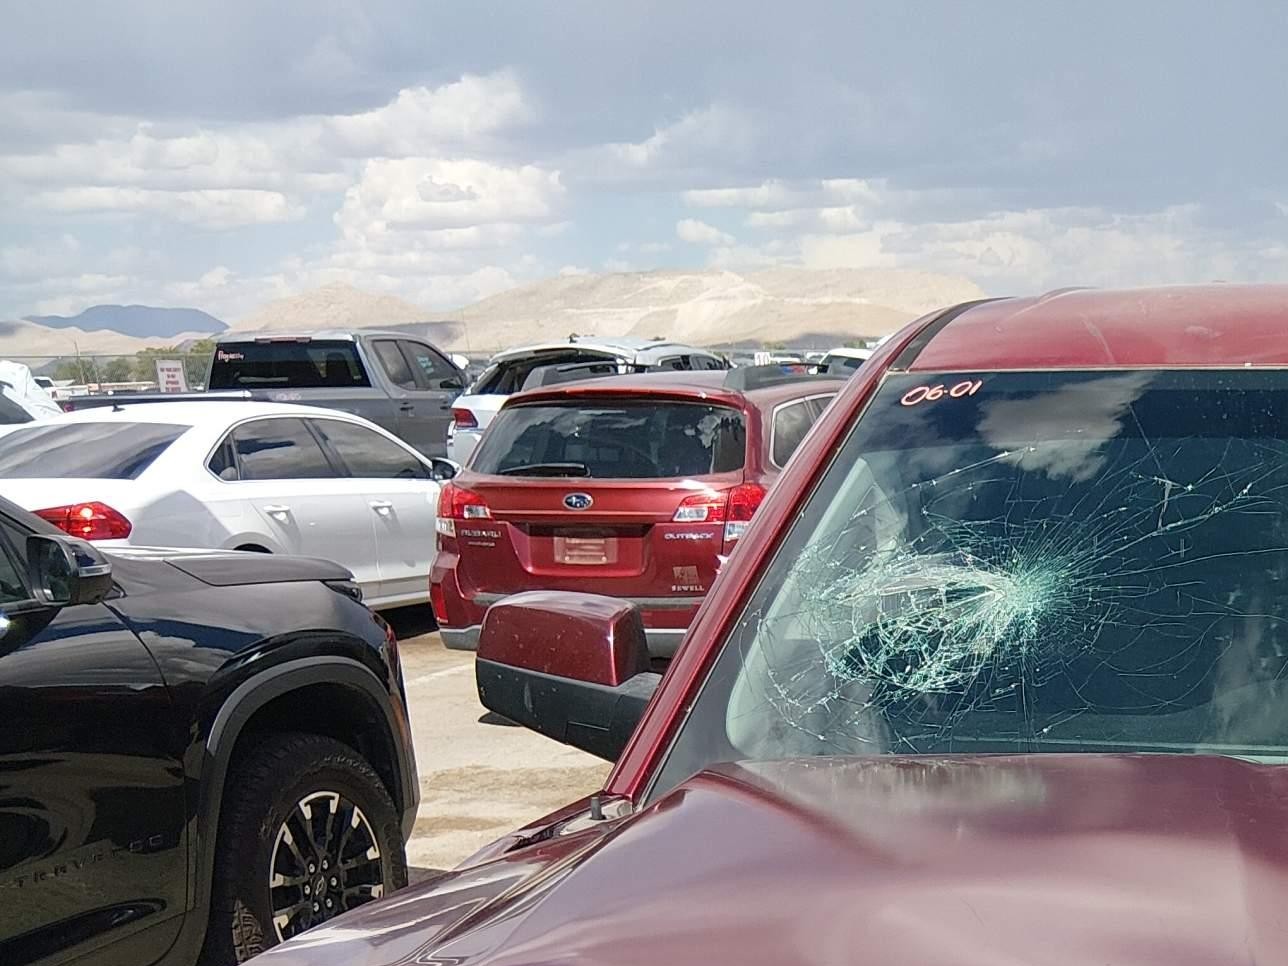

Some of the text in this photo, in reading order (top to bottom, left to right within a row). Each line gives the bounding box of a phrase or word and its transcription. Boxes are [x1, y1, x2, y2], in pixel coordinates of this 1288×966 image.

[901, 380, 983, 406] 06-01
[664, 532, 715, 540] OUTBACK
[671, 584, 705, 592] SEWELL
